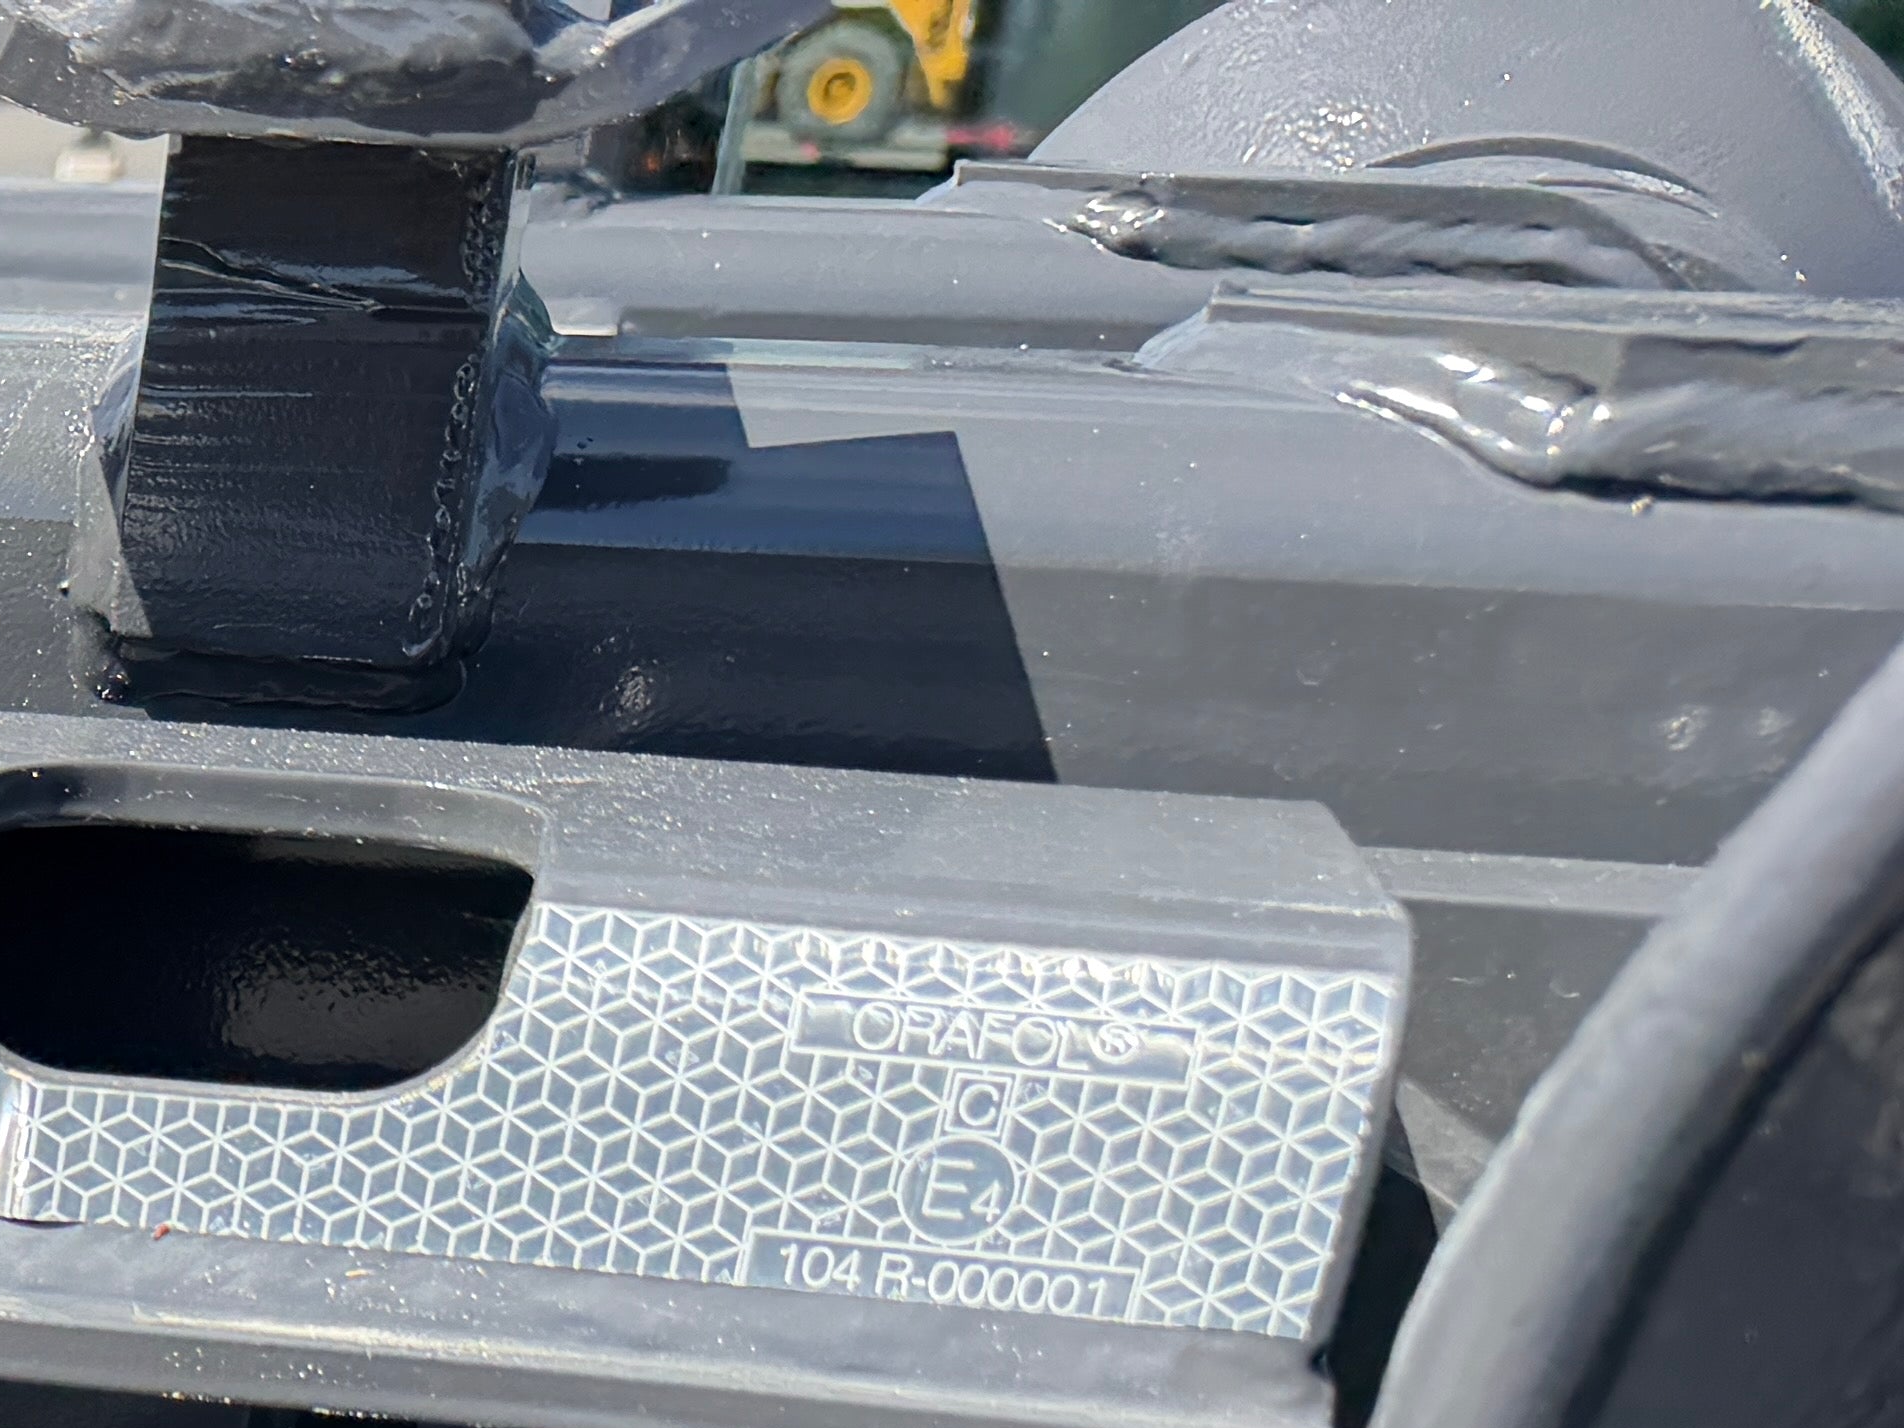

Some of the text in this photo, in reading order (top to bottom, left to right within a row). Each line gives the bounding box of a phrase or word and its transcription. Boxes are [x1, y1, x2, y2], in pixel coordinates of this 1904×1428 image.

[958, 1083, 999, 1126] C
[780, 1243, 1109, 1317] 104 R-000001
